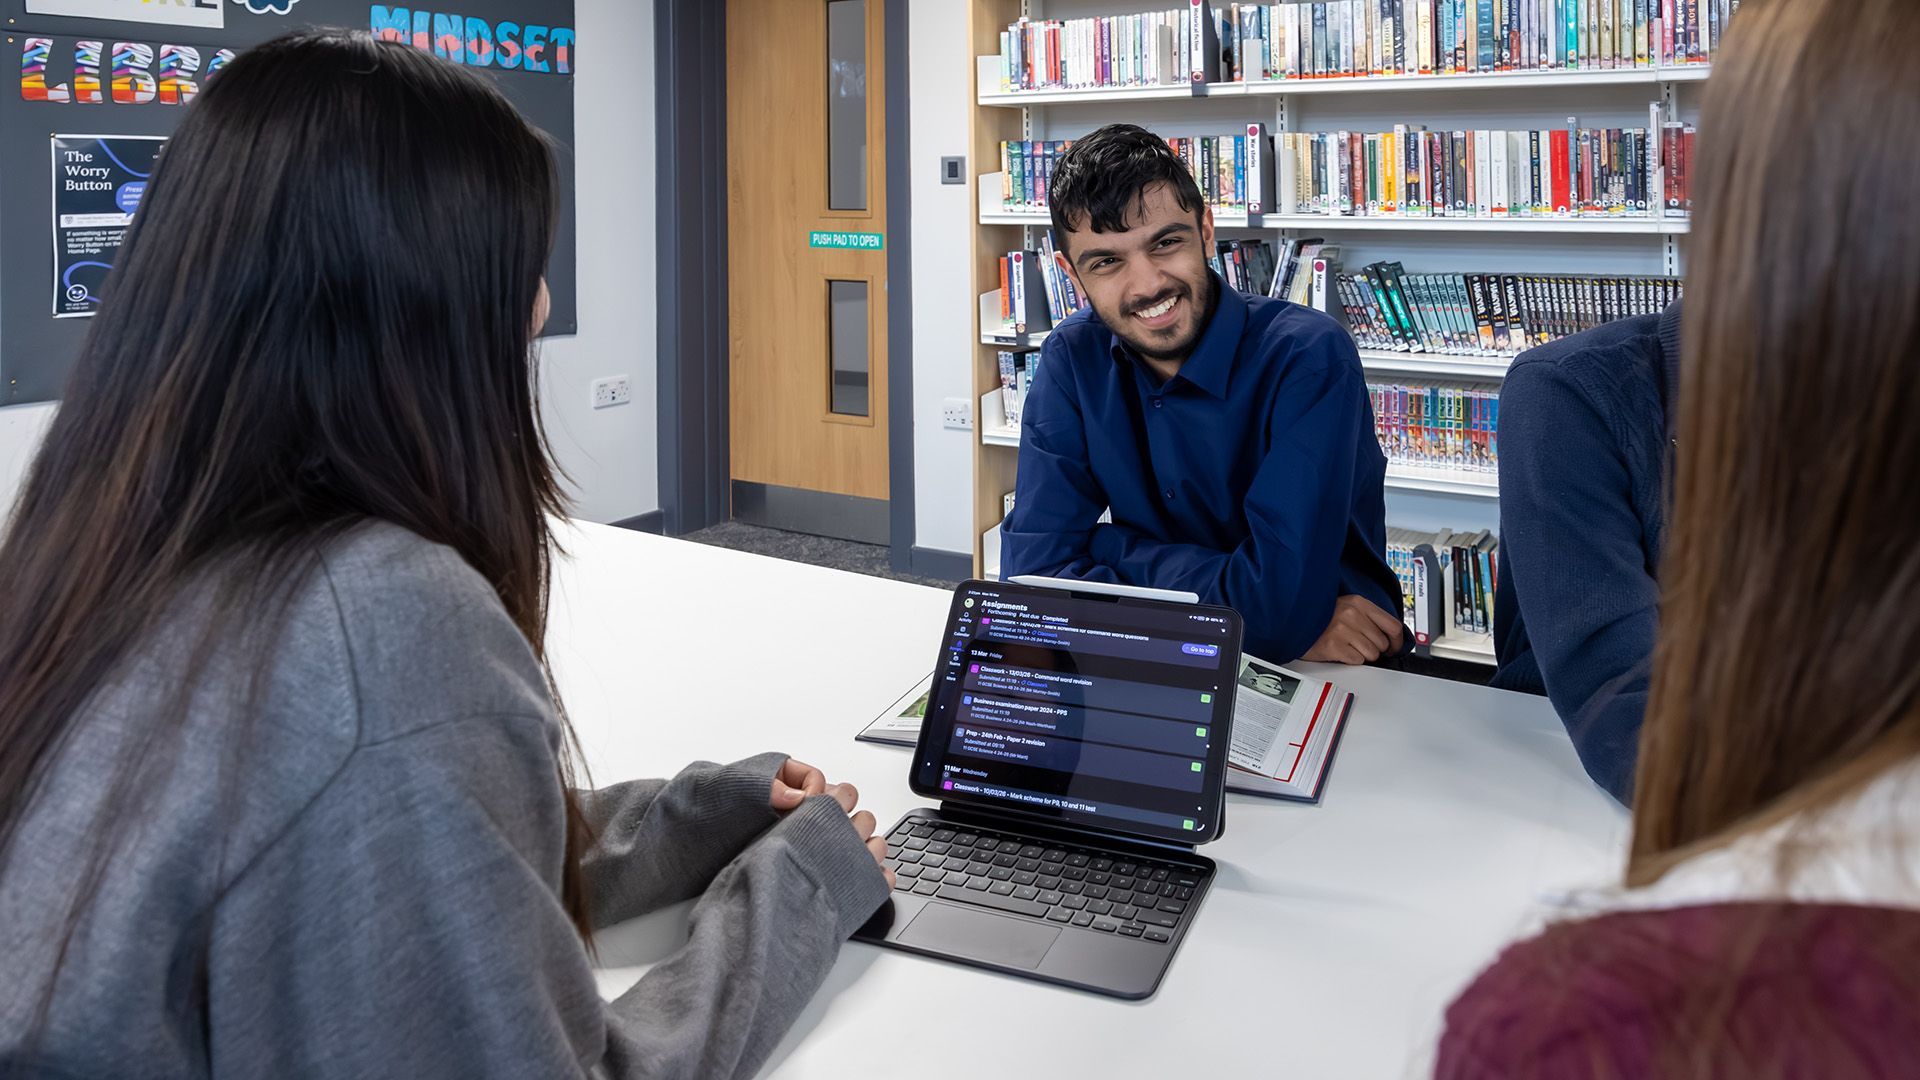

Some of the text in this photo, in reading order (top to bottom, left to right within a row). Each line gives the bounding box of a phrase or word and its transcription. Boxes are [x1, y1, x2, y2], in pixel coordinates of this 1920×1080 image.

[370, 5, 575, 74] MINDSET
[64, 150, 93, 162] The
[64, 165, 110, 180] Worry
[65, 180, 113, 191] Button
[813, 234, 880, 247] PUSH PAD TO OPEN
[981, 600, 1028, 611] Assignments
[1041, 615, 1068, 623] Completed
[980, 666, 1005, 674] Classwork
[1034, 673, 1059, 681] Command
[1072, 678, 1092, 686] revision
[973, 697, 995, 705] Business
[995, 700, 1024, 709] examination
[1025, 738, 1046, 746] revision
[962, 767, 988, 777] Wednesday
[953, 783, 980, 793] Classwork
[983, 788, 1006, 797] 10/03/26
[1009, 792, 1022, 800] Mark
[1023, 794, 1043, 803] scheme
